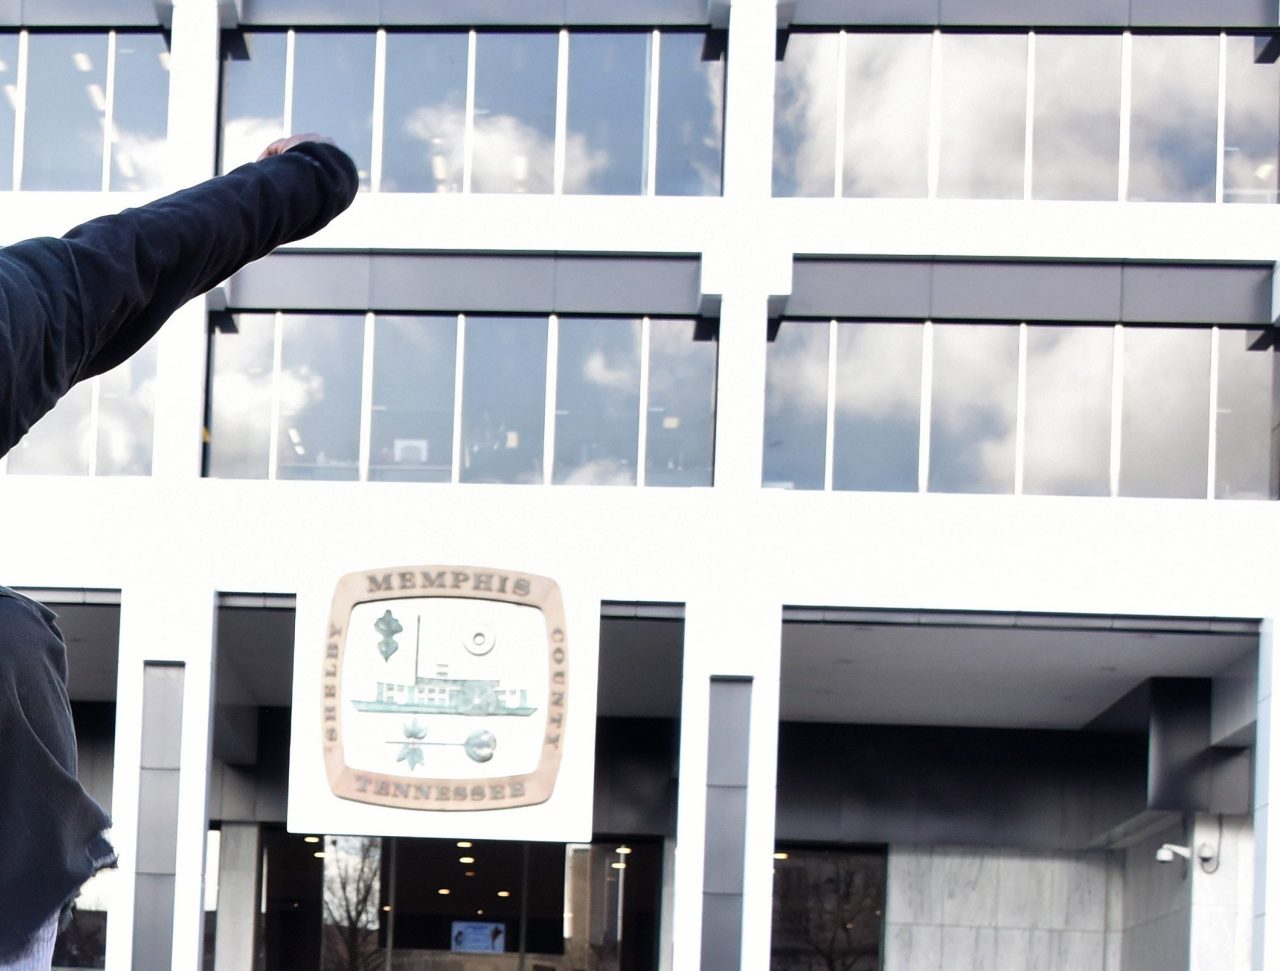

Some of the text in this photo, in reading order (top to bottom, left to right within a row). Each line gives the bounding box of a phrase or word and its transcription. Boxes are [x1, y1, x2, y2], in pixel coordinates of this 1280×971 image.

[367, 570, 532, 597] MEMPHIS
[324, 623, 343, 743] SHELBY
[544, 628, 566, 751] COUNTY
[353, 775, 527, 802] TENNESSEE
